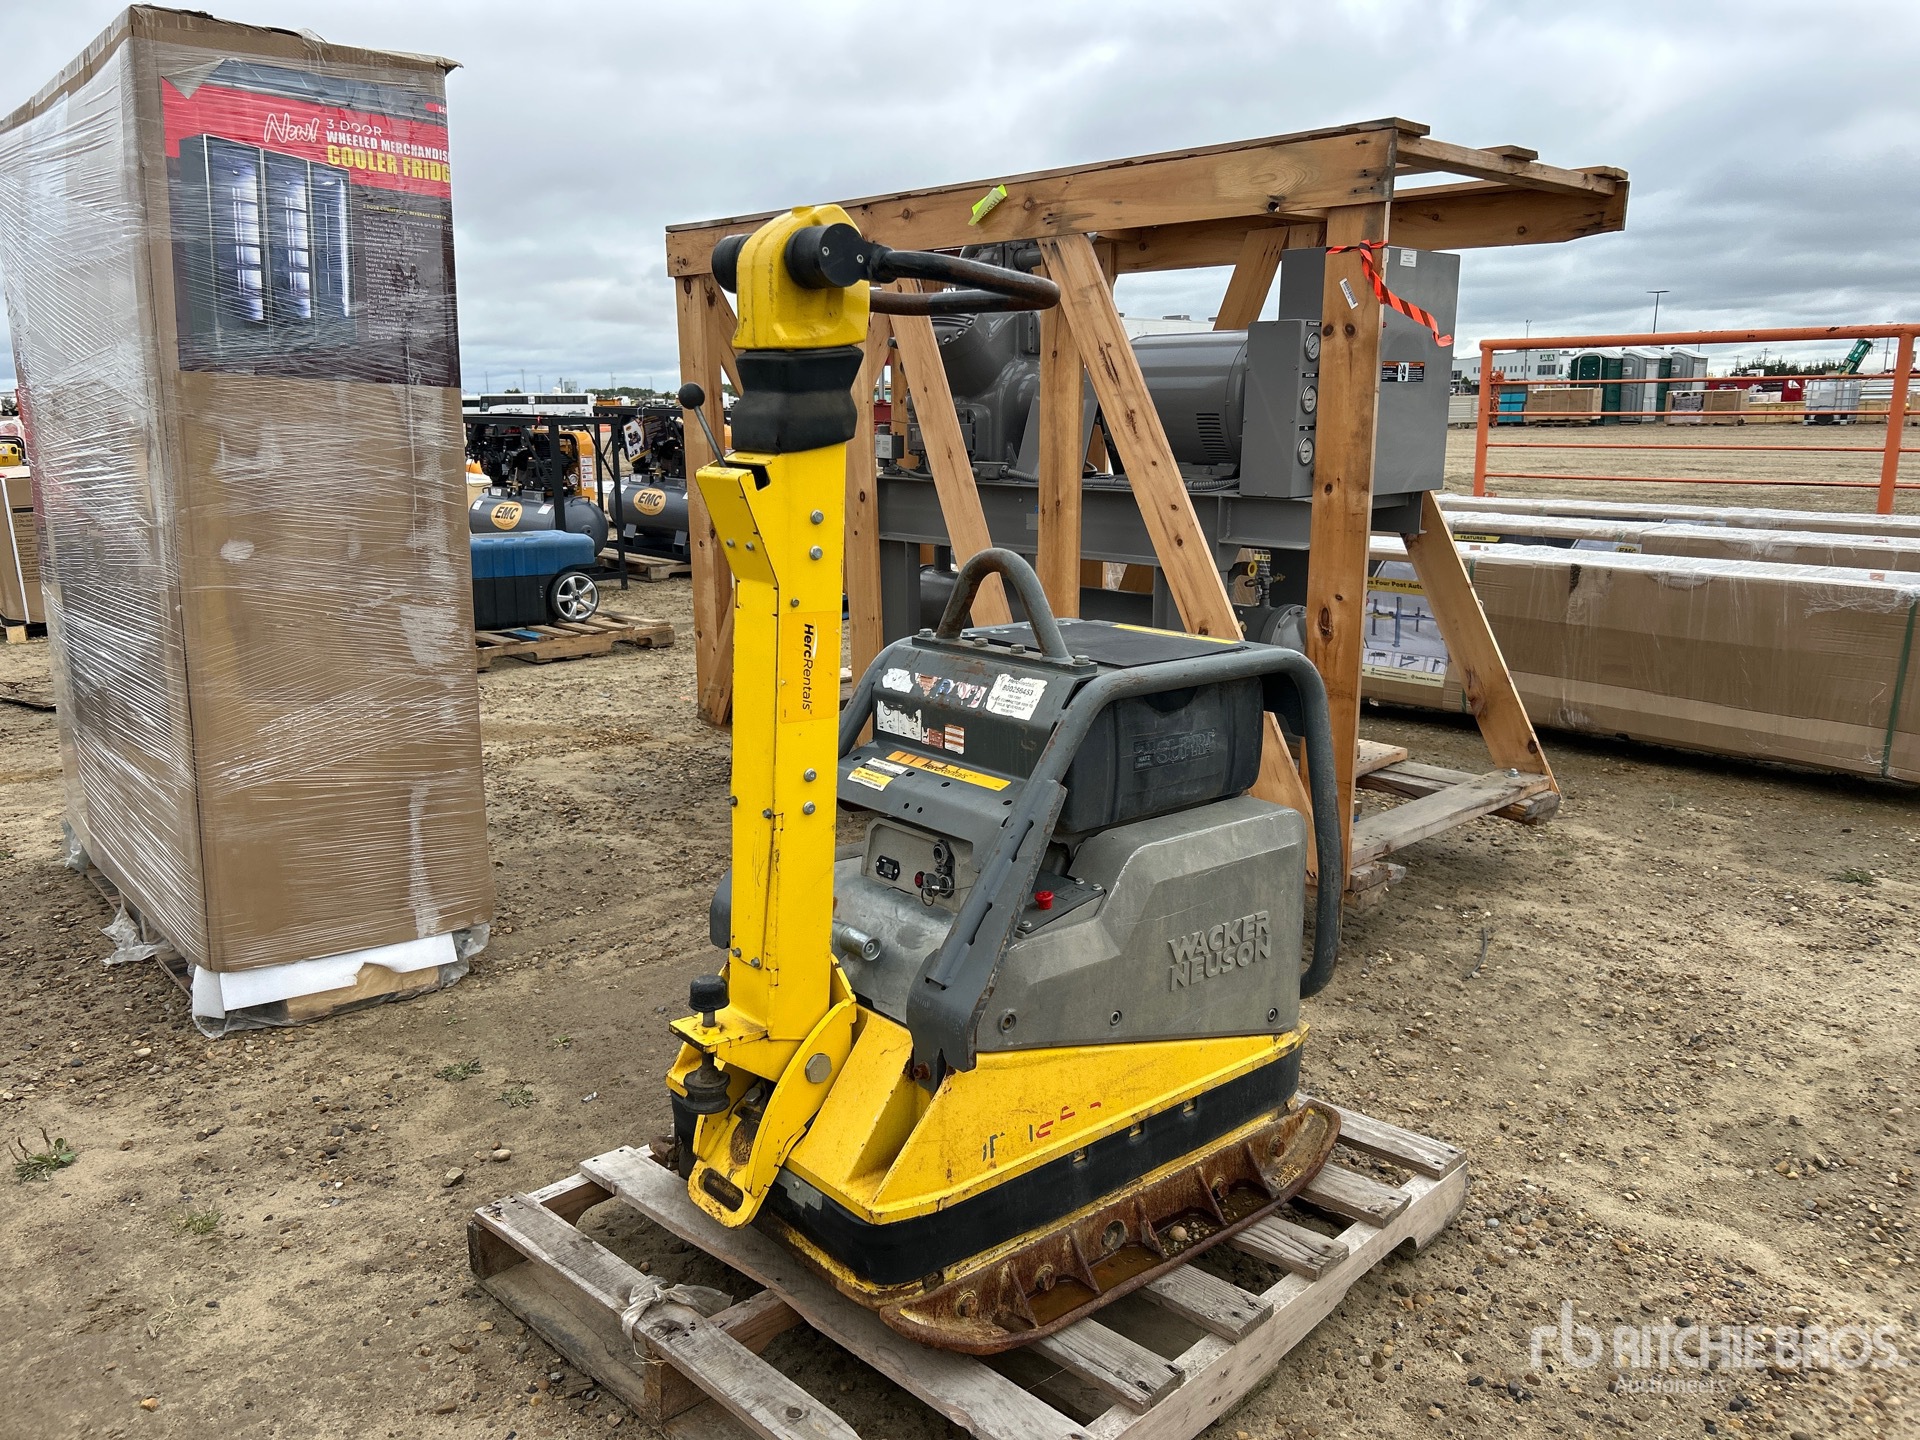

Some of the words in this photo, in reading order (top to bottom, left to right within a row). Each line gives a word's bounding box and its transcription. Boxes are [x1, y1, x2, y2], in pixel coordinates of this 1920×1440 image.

[263, 112, 320, 143] New!
[326, 118, 335, 129] 3
[340, 120, 382, 137] DOOR
[326, 130, 378, 149] WHEELED
[327, 145, 398, 175] COOLER
[637, 491, 662, 507] EMC
[494, 506, 519, 520] EMC
[1167, 910, 1272, 964] WACKER
[1169, 934, 1272, 992] NEUSON
